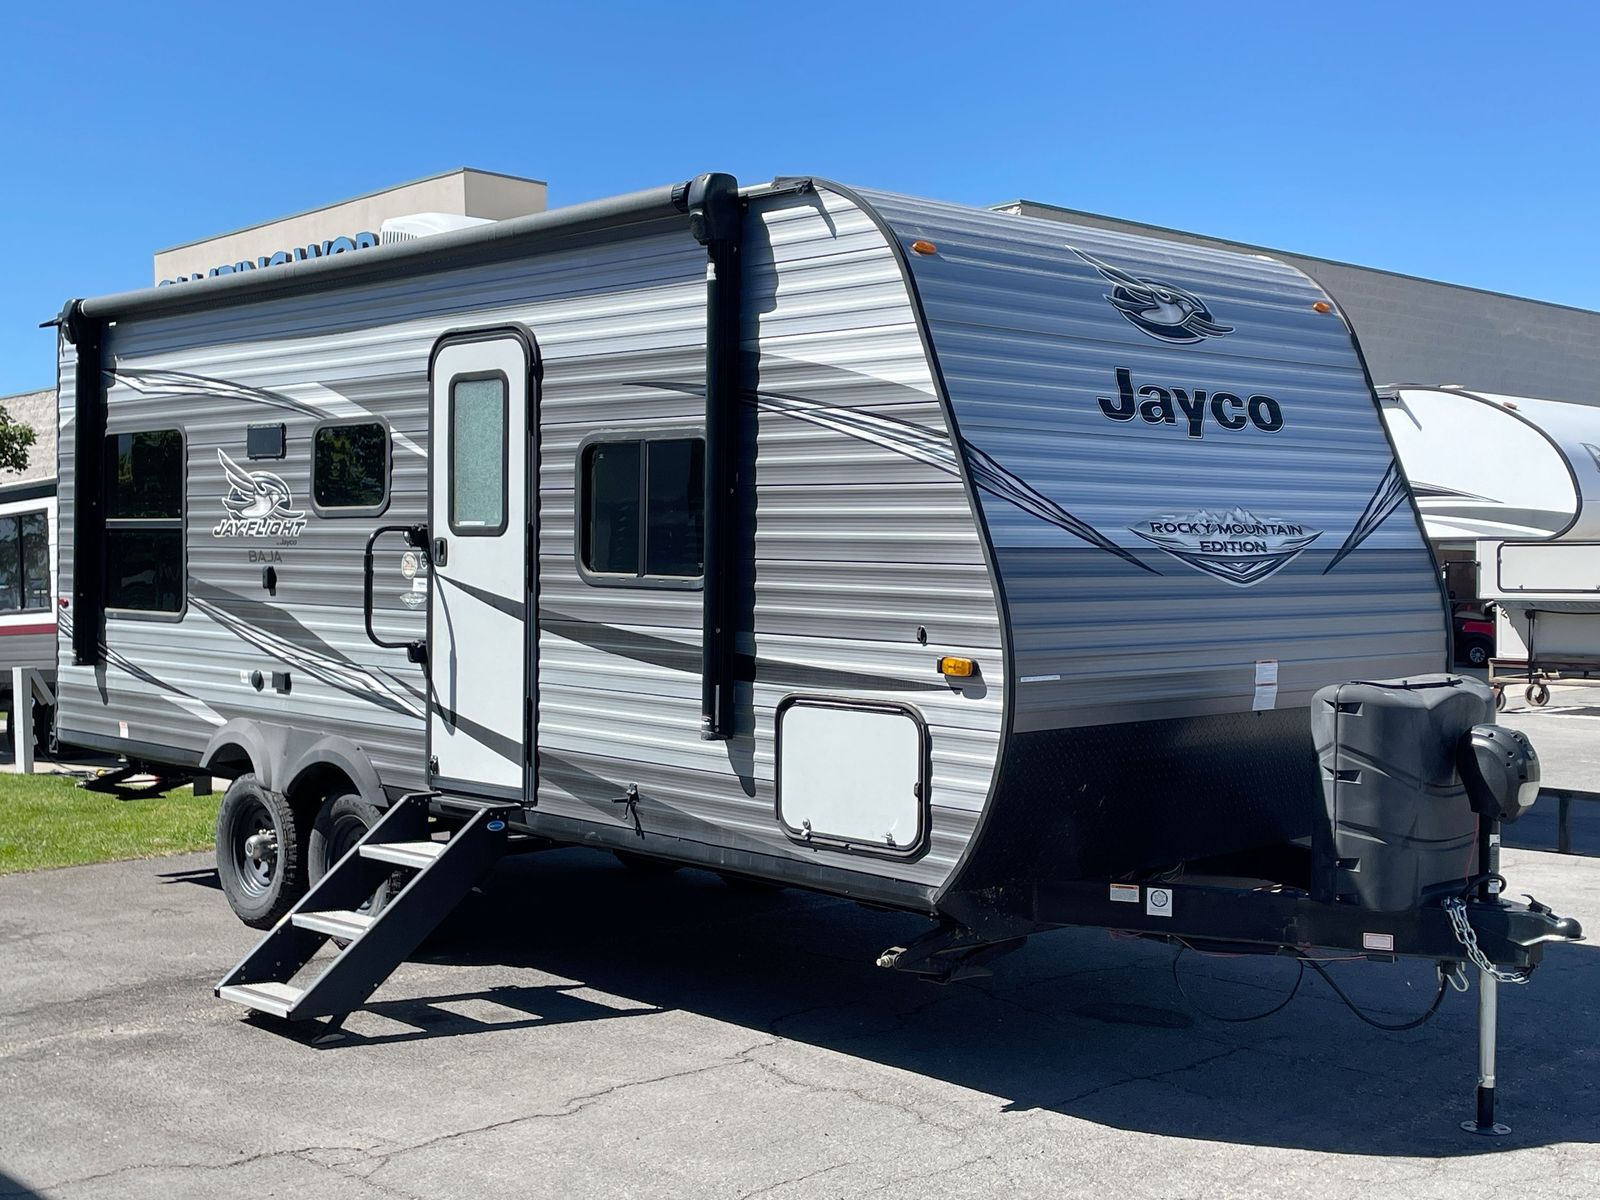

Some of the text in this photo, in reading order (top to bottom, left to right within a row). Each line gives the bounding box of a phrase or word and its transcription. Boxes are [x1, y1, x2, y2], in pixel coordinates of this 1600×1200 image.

[1097, 366, 1285, 439] Jayco
[1150, 522, 1303, 536] ROCKY MOUNTAIN
[1200, 541, 1267, 553] EDITION
[248, 550, 282, 562] BAJA
